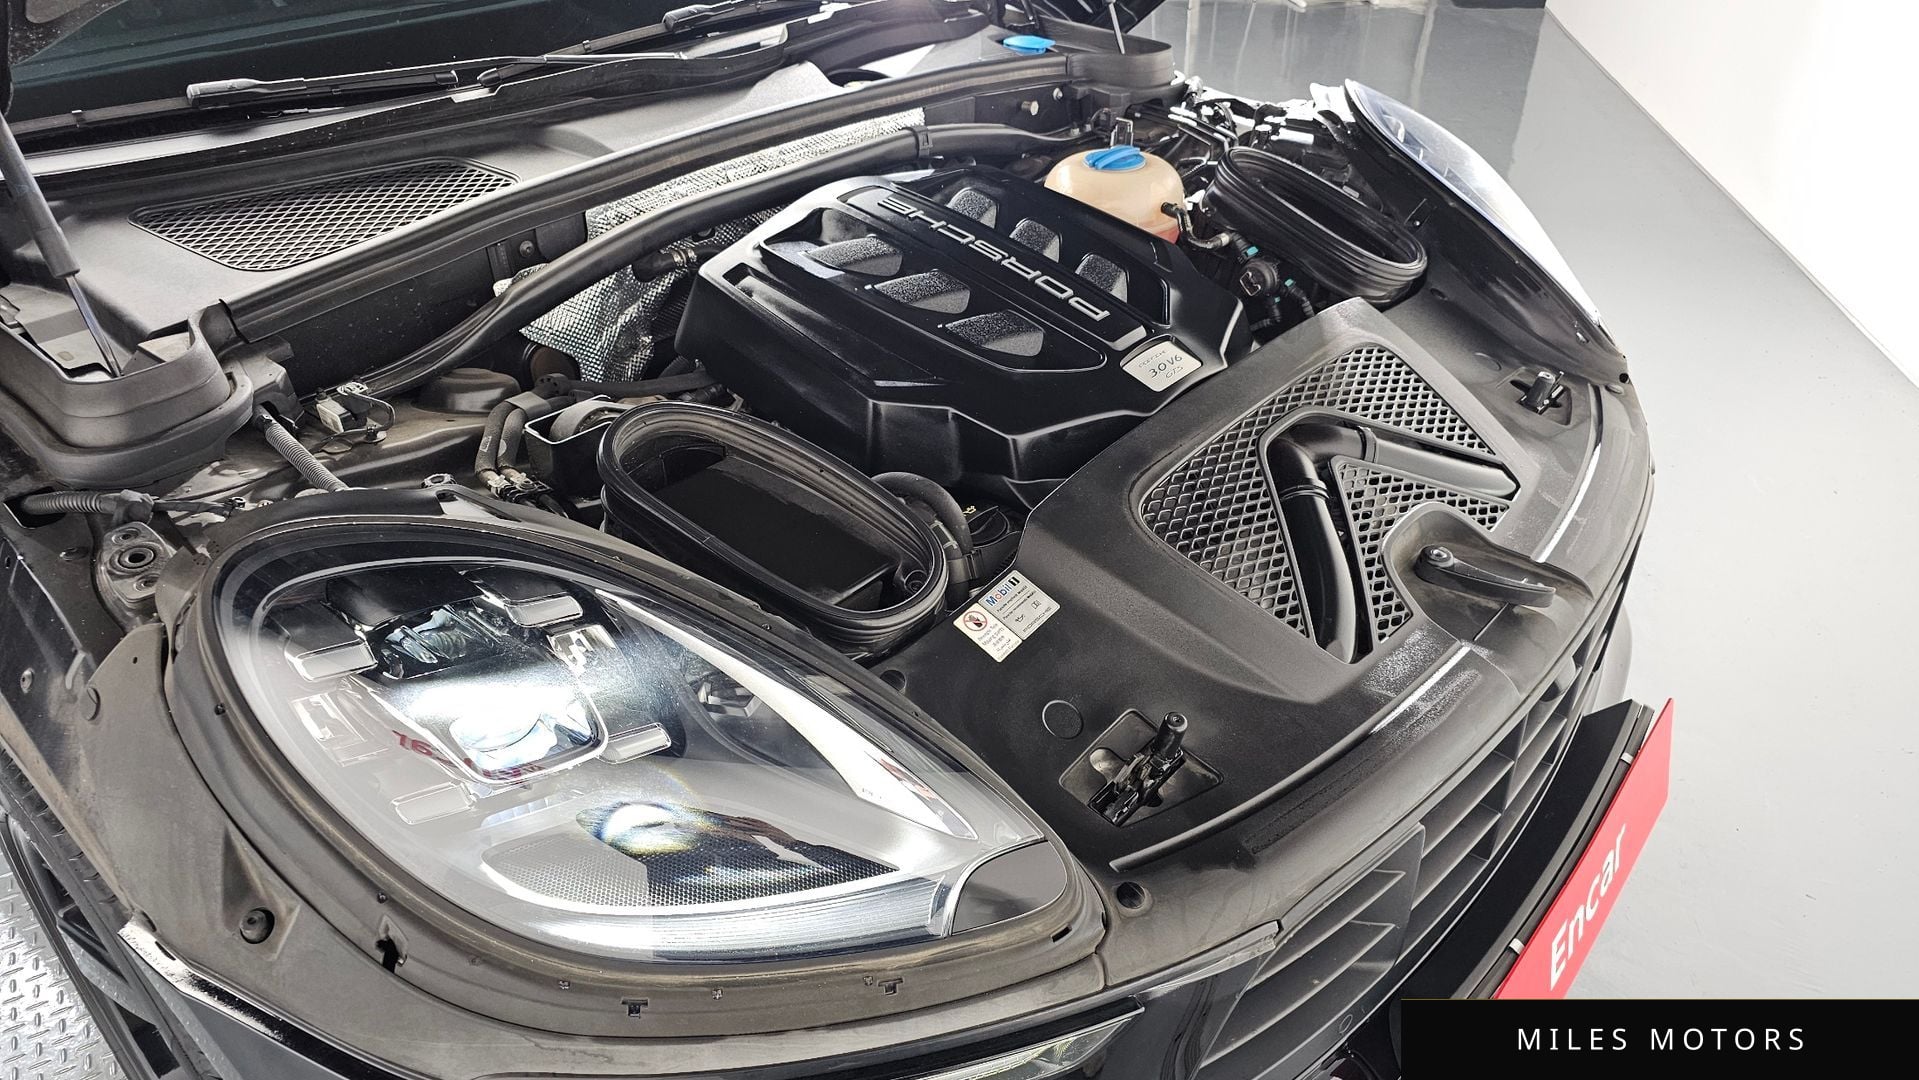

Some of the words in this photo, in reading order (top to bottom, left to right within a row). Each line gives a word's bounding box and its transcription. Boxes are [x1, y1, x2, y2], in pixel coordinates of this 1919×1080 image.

[877, 197, 1111, 322] PORSCHE
[985, 583, 1013, 607] Mobil
[1550, 823, 1627, 992] Encar
